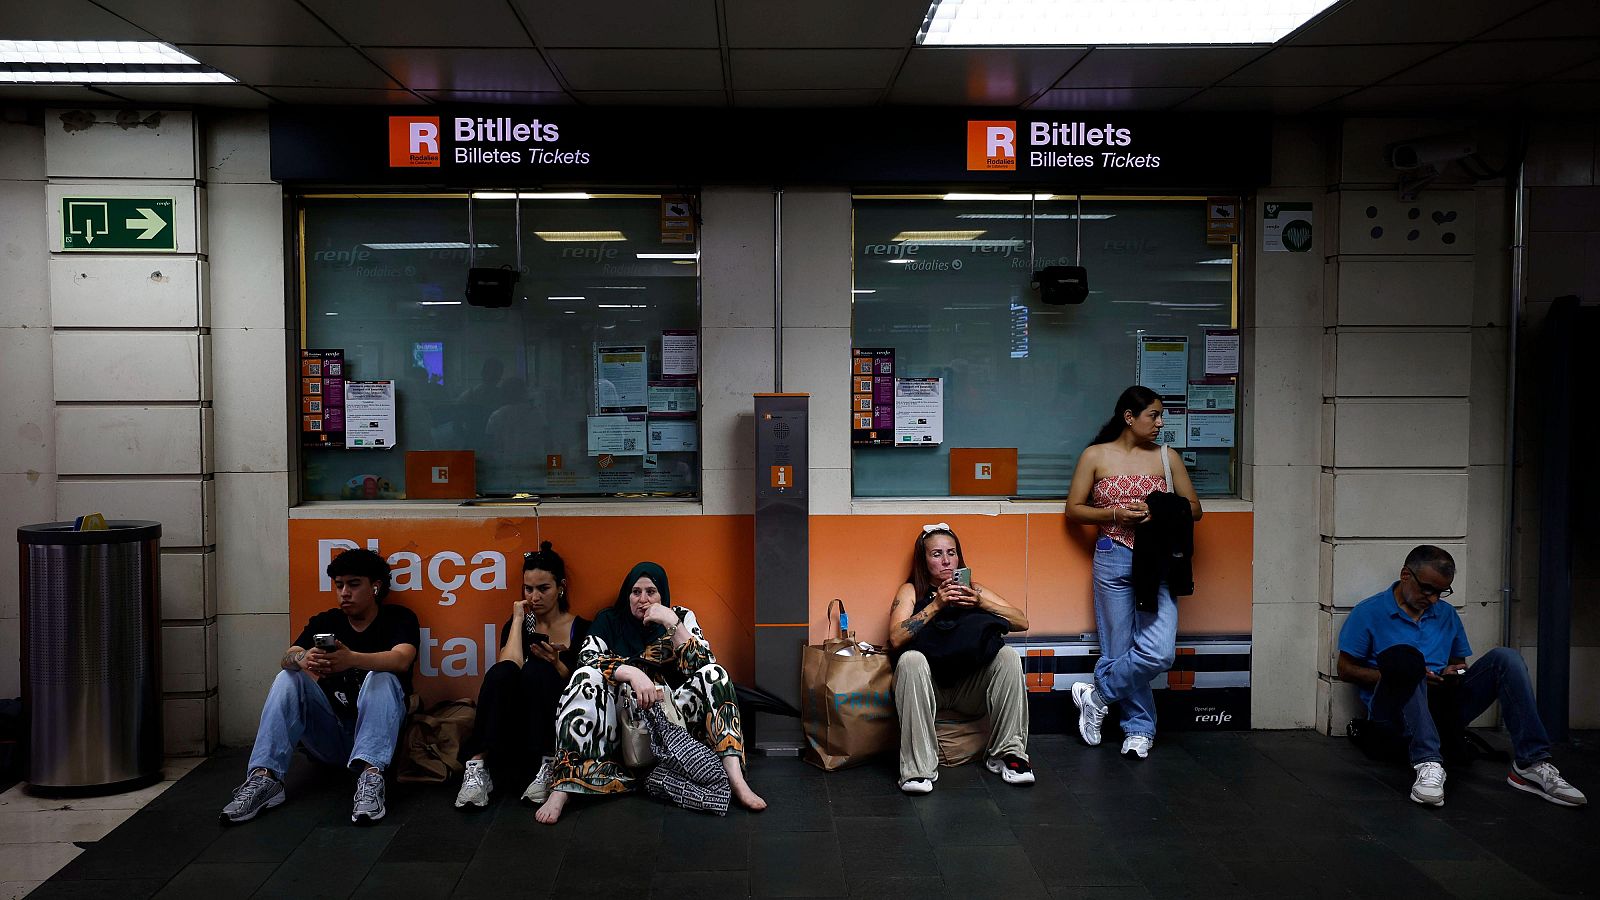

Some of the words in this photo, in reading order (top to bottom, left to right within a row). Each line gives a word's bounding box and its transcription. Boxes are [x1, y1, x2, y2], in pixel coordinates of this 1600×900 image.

[409, 122, 438, 153] R
[455, 118, 559, 142] Bitllets
[1030, 122, 1131, 146] Bitllets
[986, 126, 1014, 157] R
[455, 147, 521, 164] Billetes
[528, 148, 590, 164] Tickets
[1030, 152, 1094, 167] Billetes
[1101, 152, 1161, 168] Tickets
[314, 244, 371, 266] renfe
[562, 243, 618, 263] renfe
[864, 239, 920, 261] renfe
[970, 236, 1025, 258] renfe
[904, 259, 949, 271] Rodalies
[439, 469, 448, 480] R
[982, 465, 990, 475] R
[317, 538, 508, 606] Paça
[1195, 710, 1232, 726] renfe
